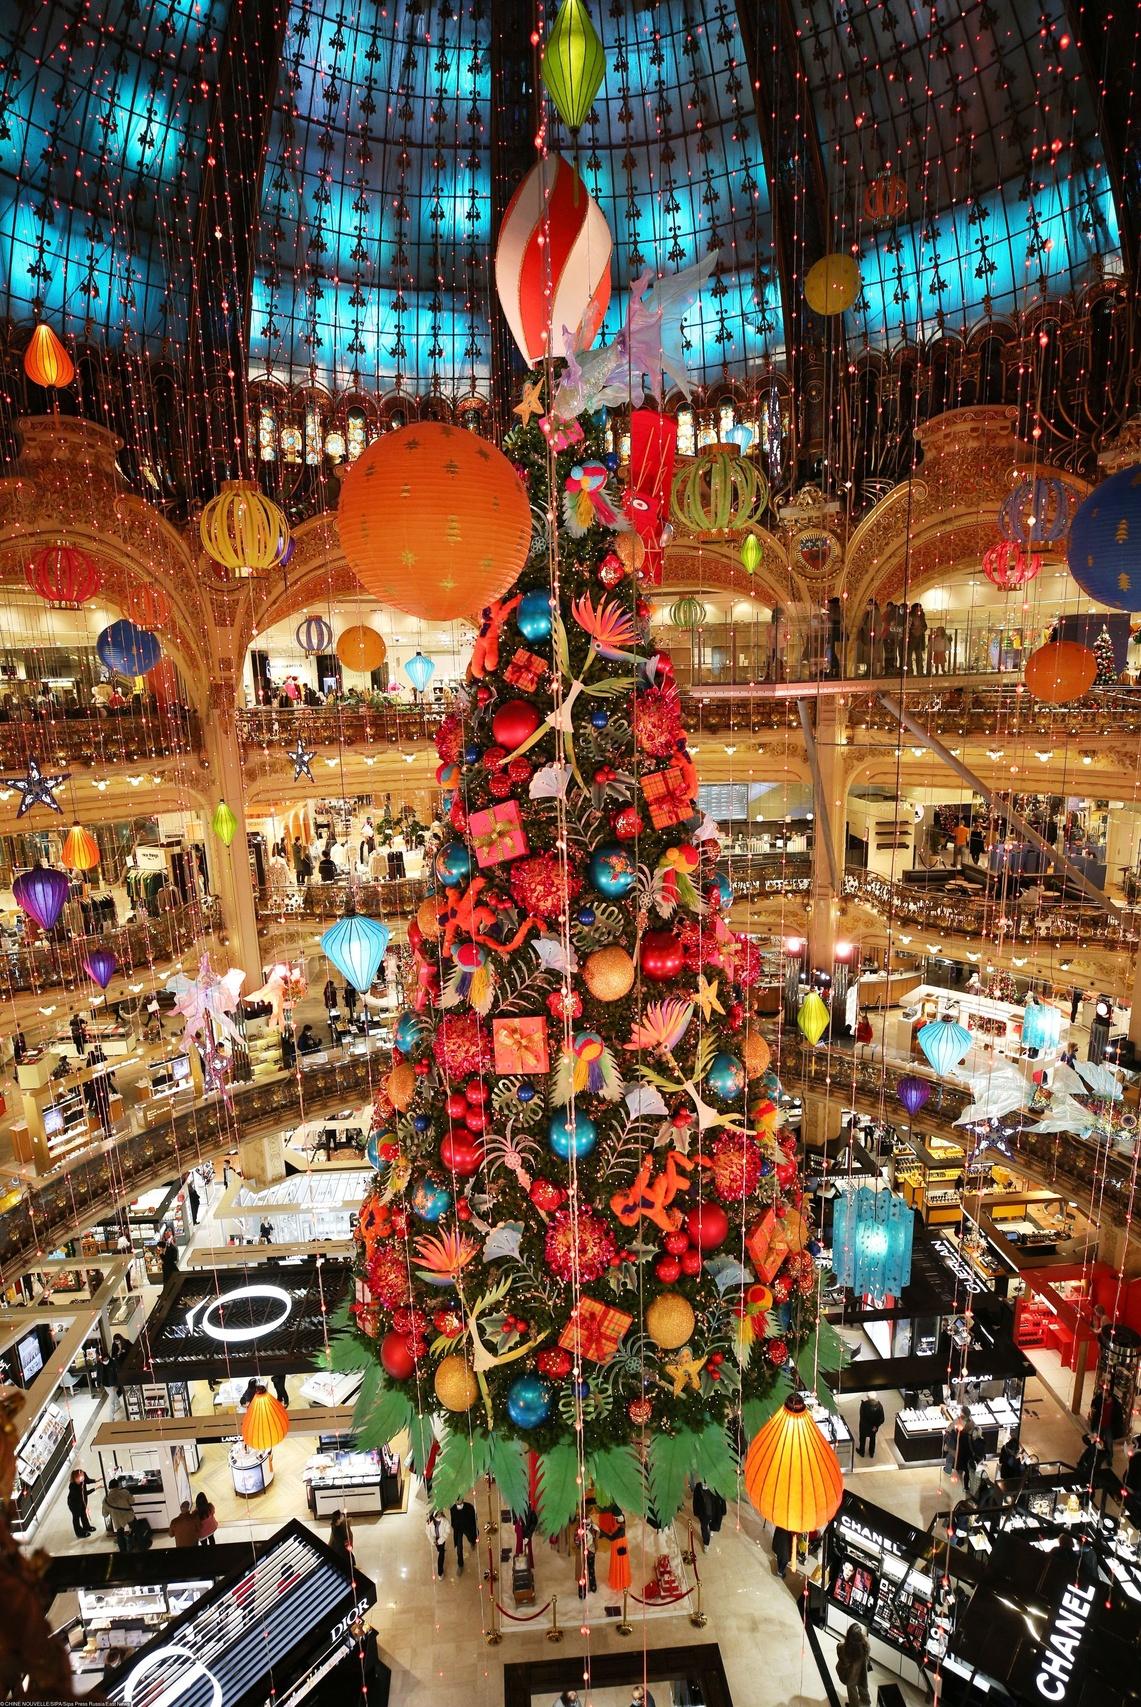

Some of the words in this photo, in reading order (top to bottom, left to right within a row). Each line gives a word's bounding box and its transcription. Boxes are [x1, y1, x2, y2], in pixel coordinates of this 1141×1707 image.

[931, 1240, 981, 1294] GUERLAIN
[951, 1374, 993, 1384] GUERLAIN
[841, 1515, 902, 1557] CHANEL
[330, 1598, 370, 1643] DIOR
[1036, 1583, 1096, 1702] CHANEL
